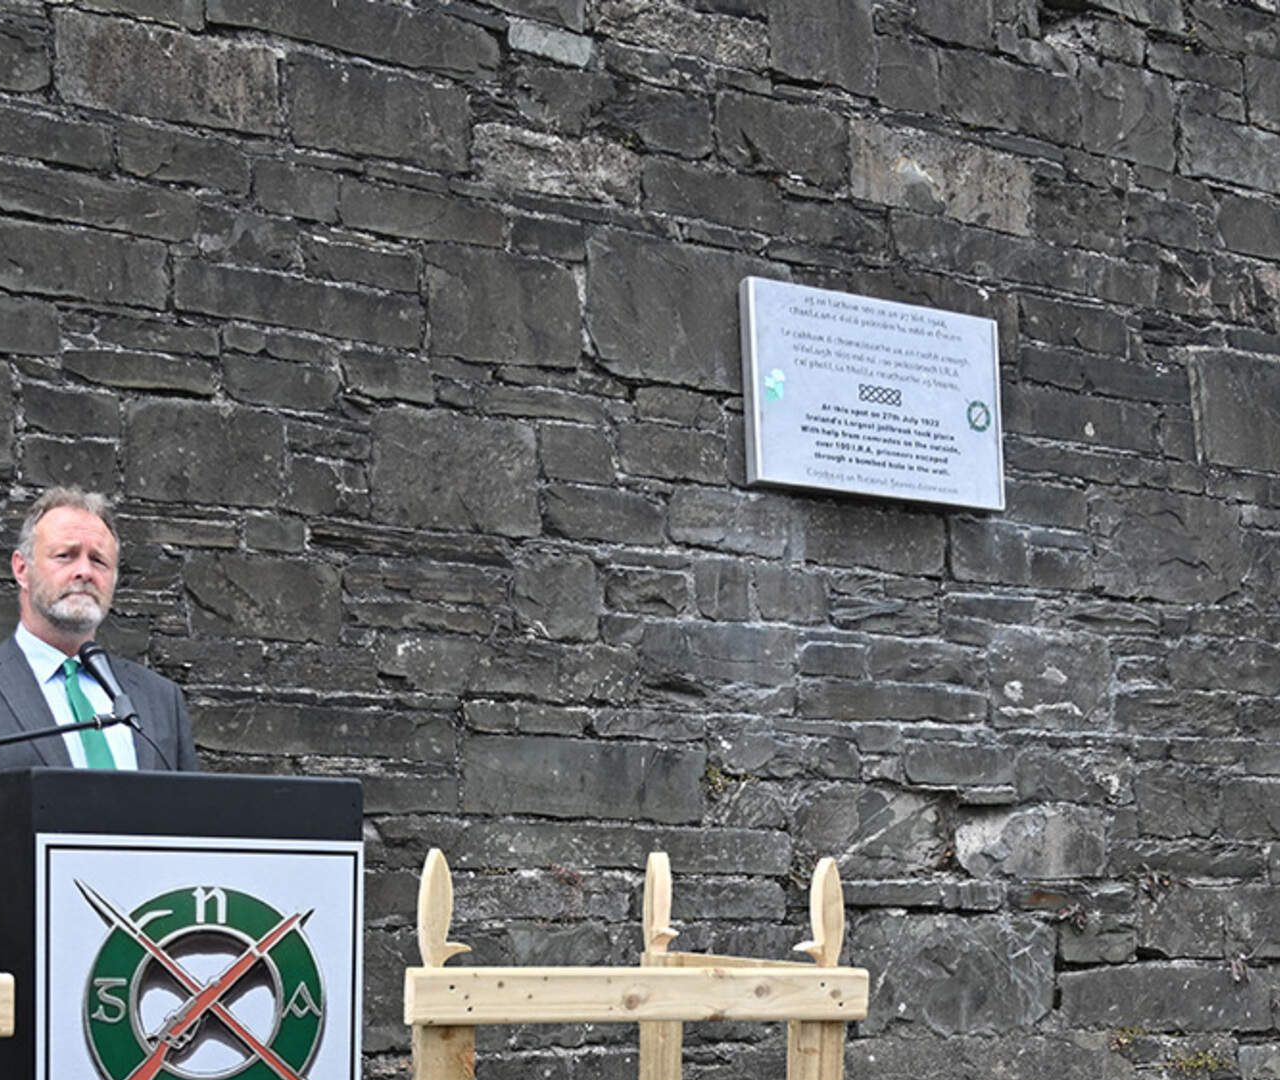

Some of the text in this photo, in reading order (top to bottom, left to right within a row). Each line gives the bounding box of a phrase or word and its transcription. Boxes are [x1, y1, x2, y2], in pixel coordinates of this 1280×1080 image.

[850, 408, 868, 417] spot
[870, 410, 879, 419] on
[821, 428, 839, 438] help
[841, 431, 859, 441] from
[903, 439, 912, 447] on
[914, 440, 926, 449] the
[813, 452, 845, 463] through
[916, 464, 928, 472] the
